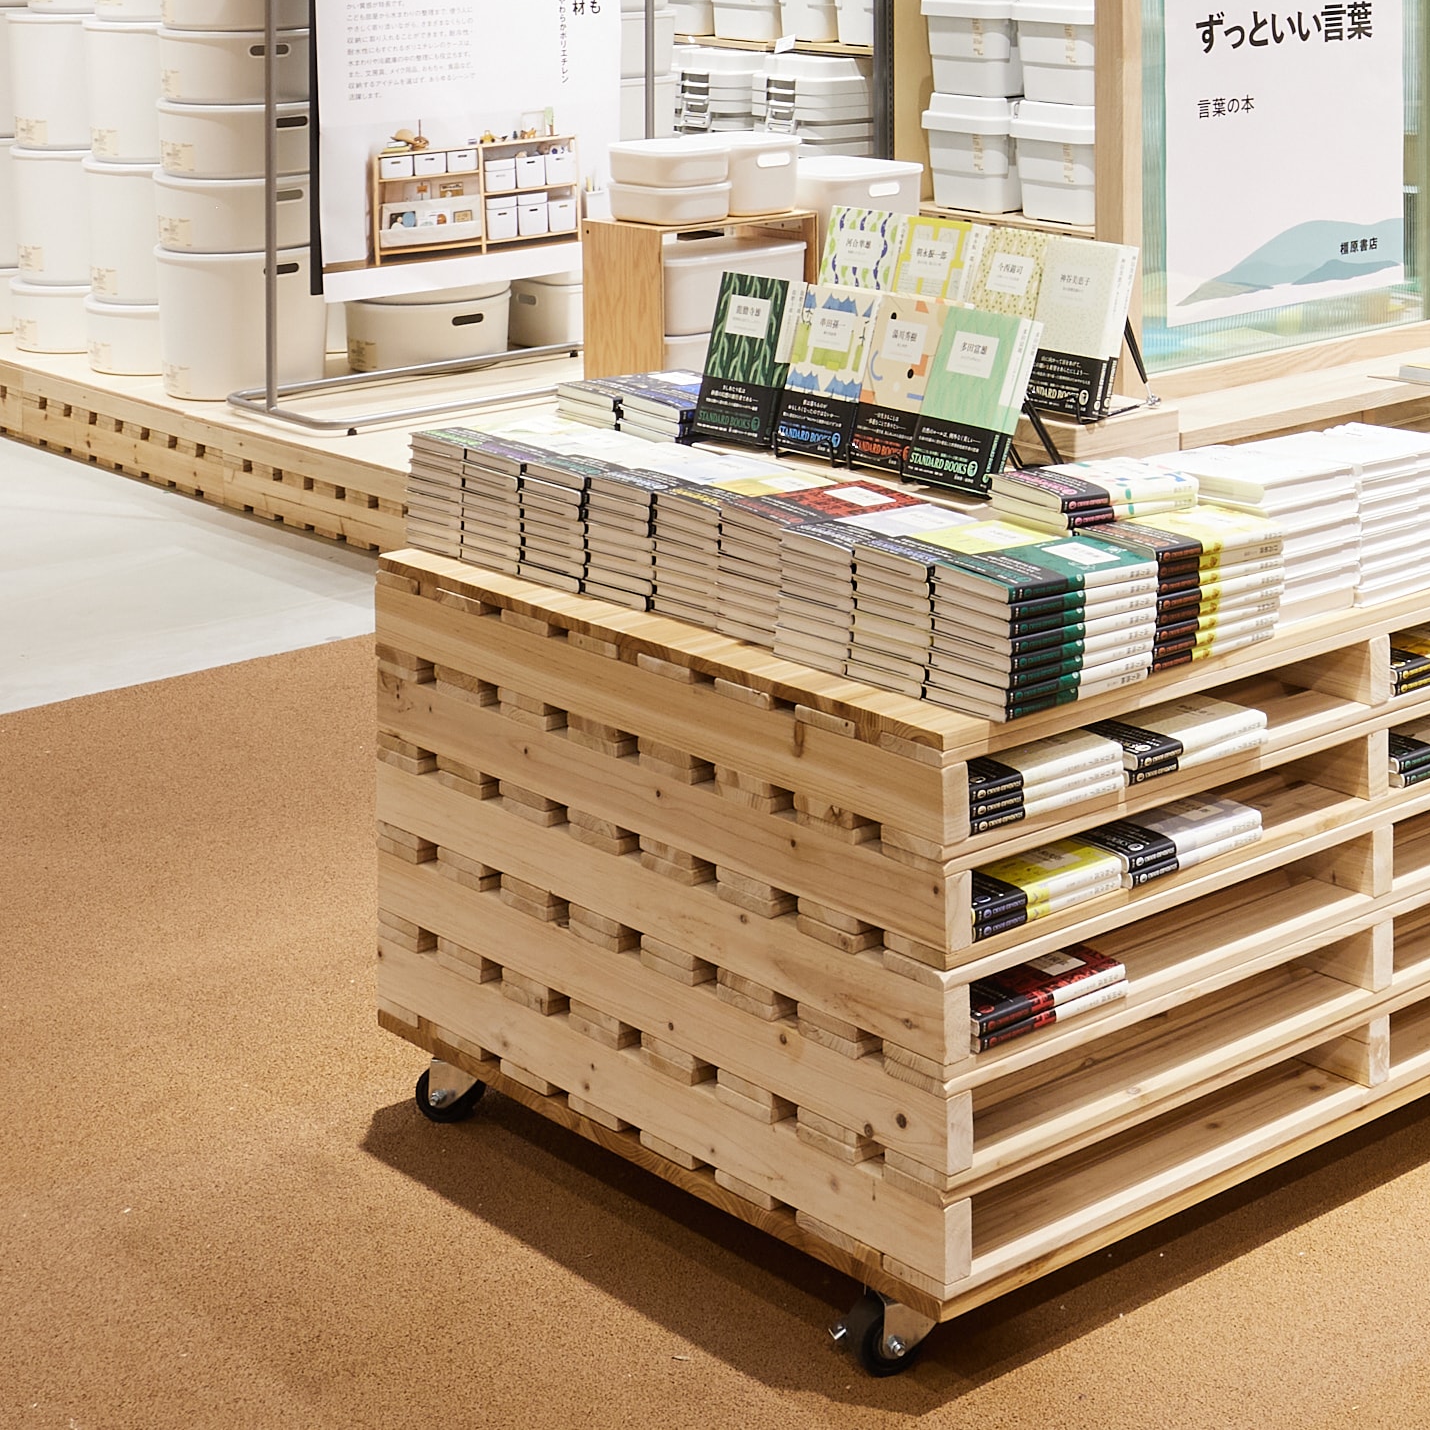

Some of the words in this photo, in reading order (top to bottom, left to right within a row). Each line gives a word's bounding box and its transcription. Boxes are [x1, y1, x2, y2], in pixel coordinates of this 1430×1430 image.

[1195, 1, 1373, 53] ずっといい言葉
[1197, 93, 1255, 119] 言葉の本
[699, 410, 729, 425] STANDARD
[729, 416, 751, 429] BOOKS
[910, 452, 944, 470] STANDARD
[944, 460, 967, 475] BOOKS
